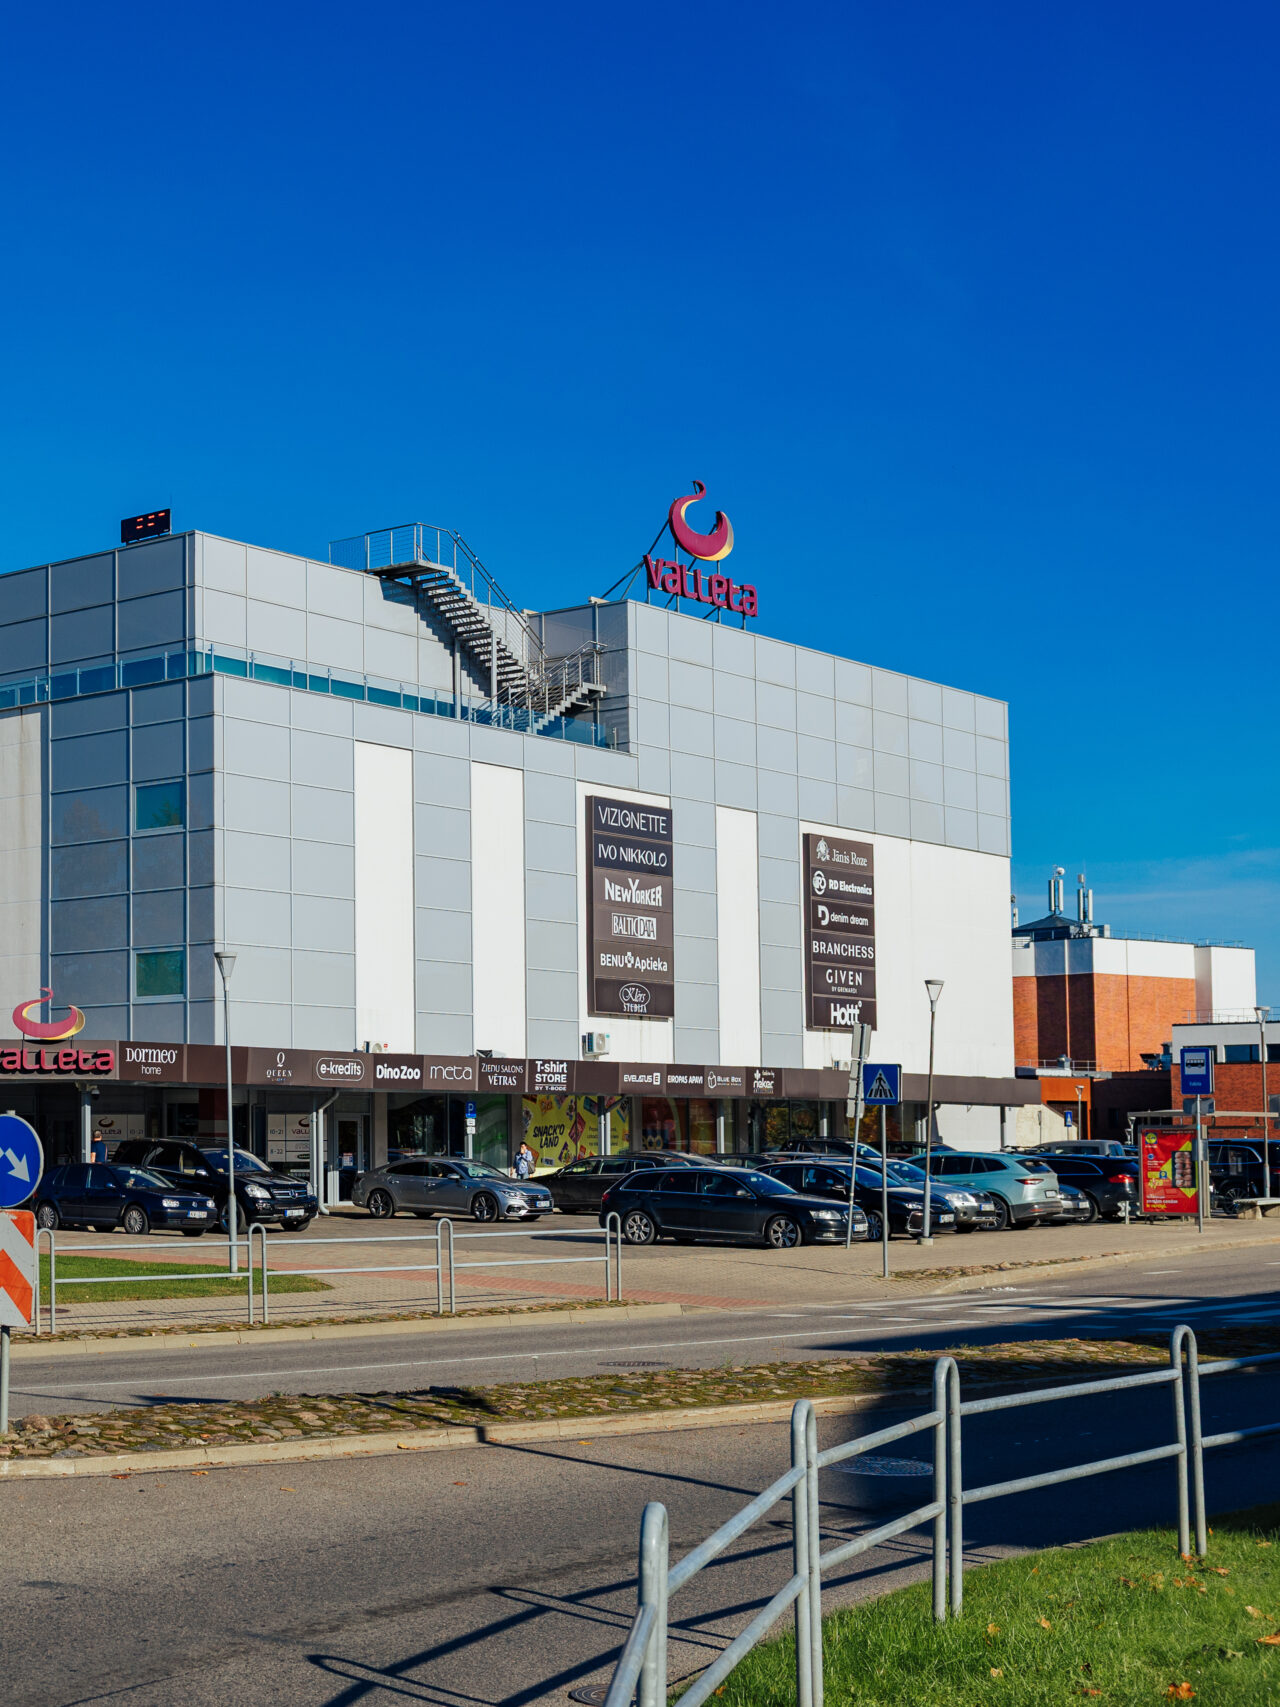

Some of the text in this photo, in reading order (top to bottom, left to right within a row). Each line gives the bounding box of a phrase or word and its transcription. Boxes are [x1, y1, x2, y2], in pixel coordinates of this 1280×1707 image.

[598, 806, 667, 834] VIZIONETTE
[598, 844, 667, 867] IVO NIKKOLO
[832, 849, 867, 866] Jānis Roze
[829, 879, 872, 895] RD Electronics
[831, 912, 868, 926] denim dream
[813, 940, 874, 959] BRANCHESS
[600, 953, 668, 972] BENU Aptieka
[826, 969, 862, 985] GIVEN
[141, 1065, 161, 1075] home
[266, 1069, 292, 1078] QUEEN
[501, 1064, 523, 1074] SALONS
[535, 1061, 567, 1073] T-shirt
[535, 1074, 567, 1083] STORE
[623, 1074, 652, 1082] EVELATUS
[533, 1124, 565, 1137] SNACK'O
[540, 1136, 559, 1148] LAND
